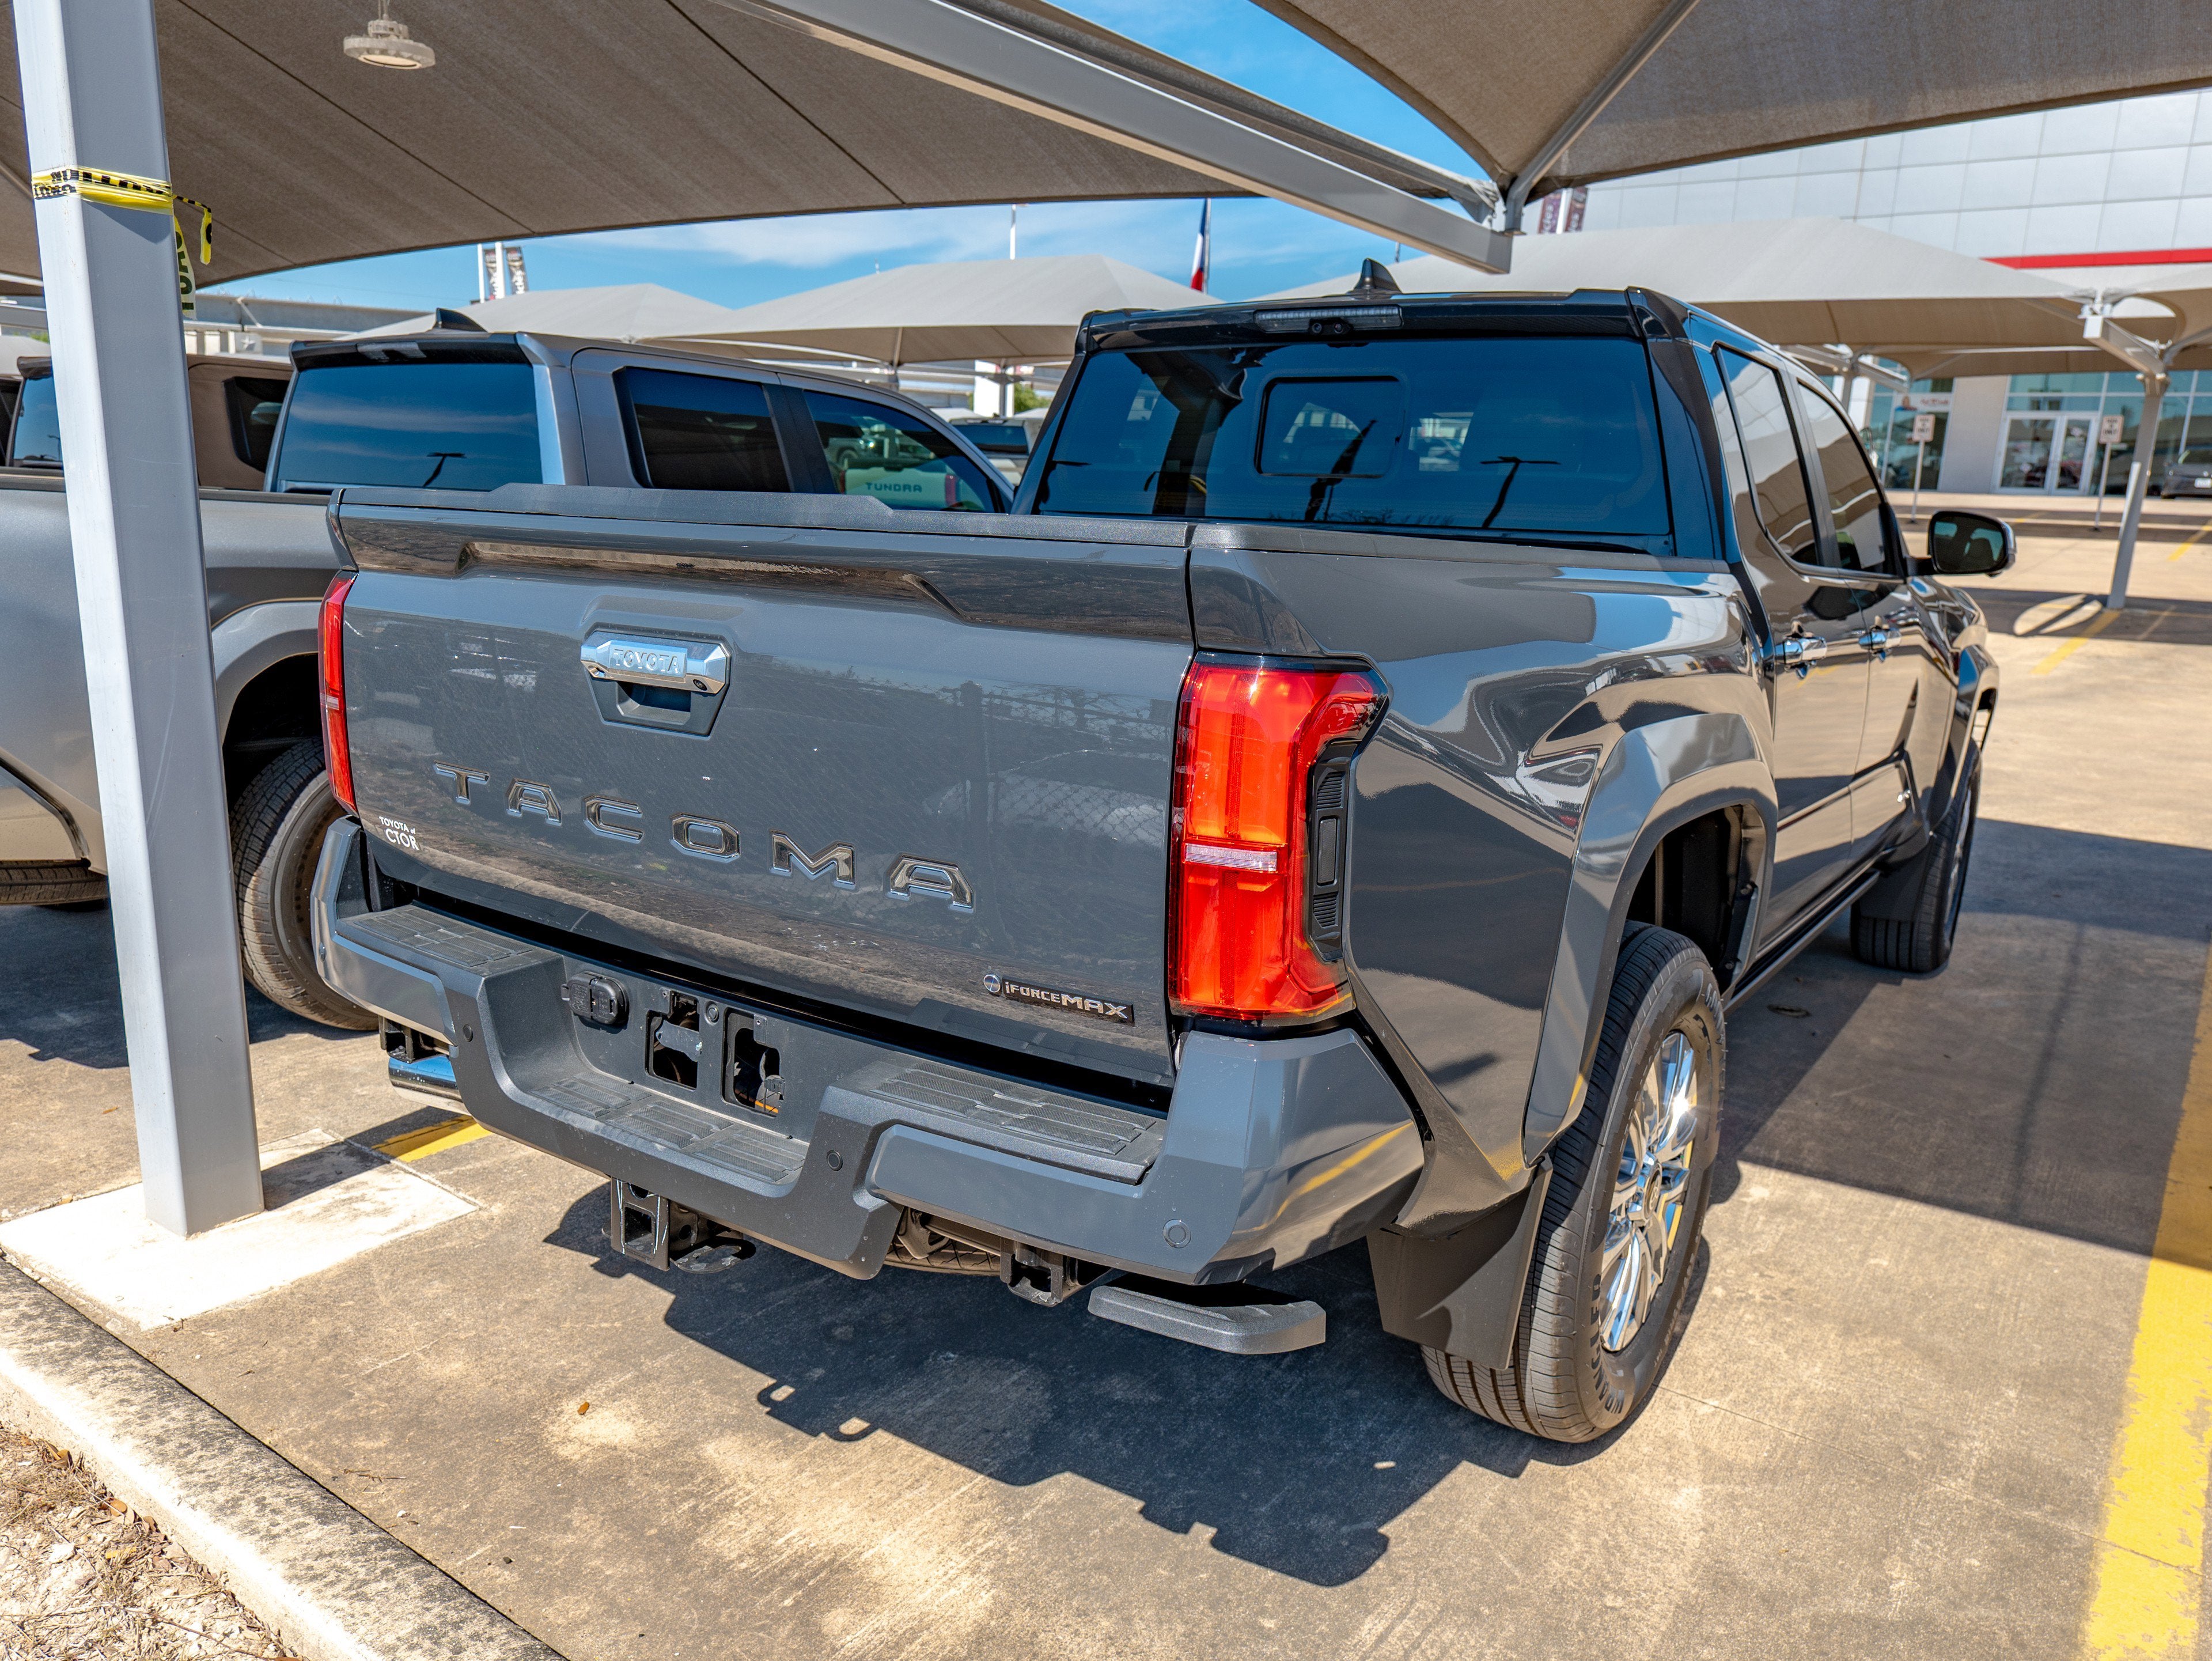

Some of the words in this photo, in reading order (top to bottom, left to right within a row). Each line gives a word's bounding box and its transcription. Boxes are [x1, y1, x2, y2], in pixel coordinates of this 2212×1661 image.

[865, 482, 923, 493] TUNDRA
[612, 649, 681, 674] TOYOTA
[379, 816, 410, 833] TOYOTA
[385, 828, 419, 850] CTOR
[433, 761, 974, 913] TACOMA
